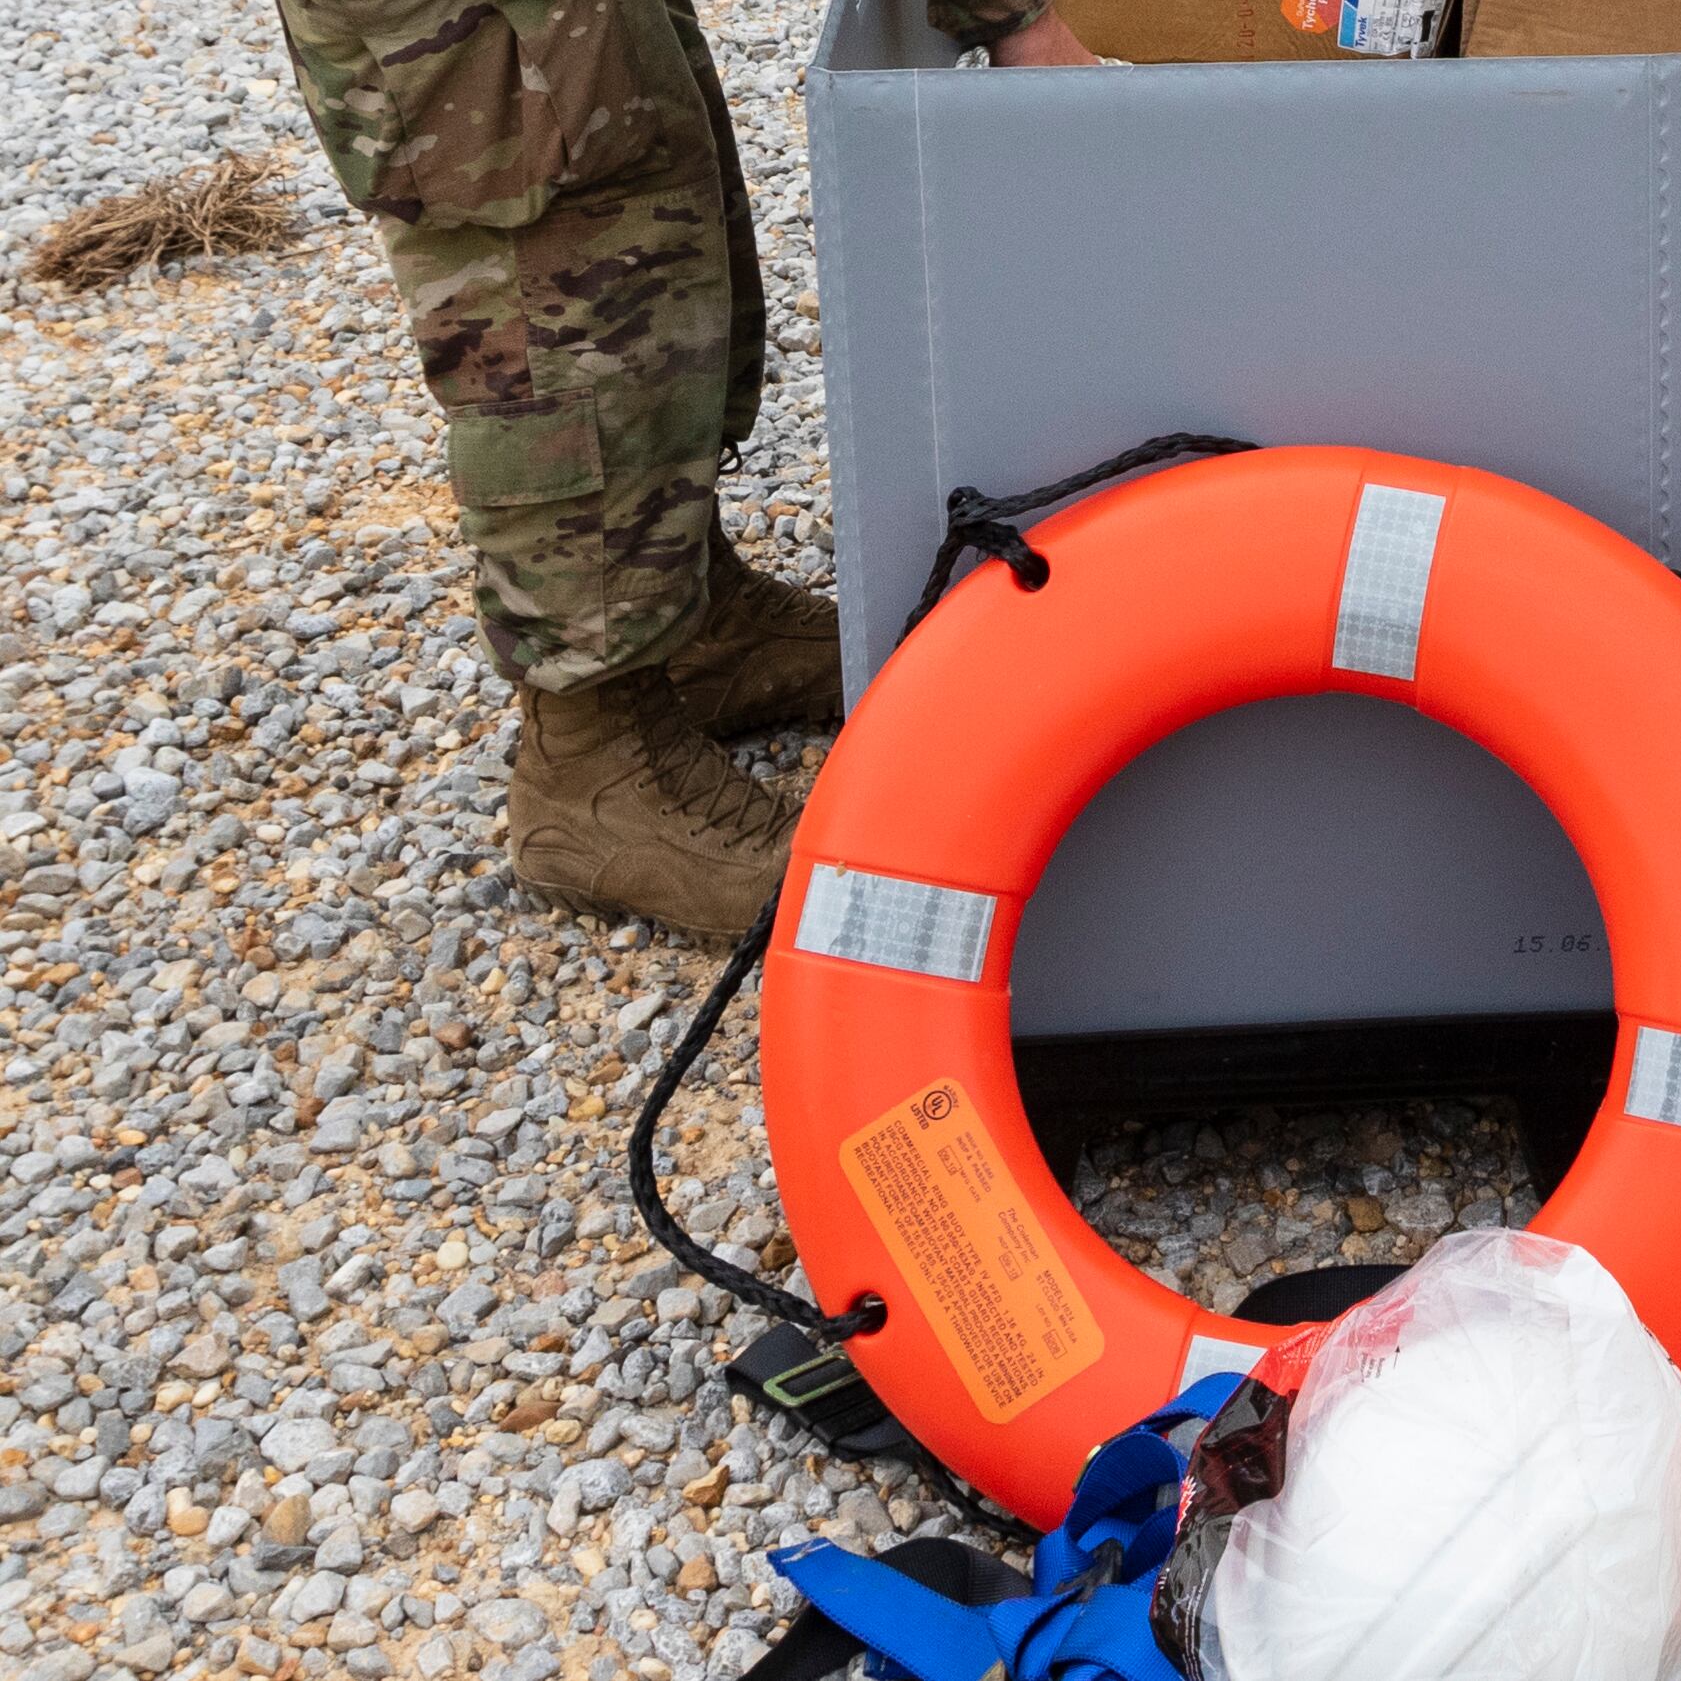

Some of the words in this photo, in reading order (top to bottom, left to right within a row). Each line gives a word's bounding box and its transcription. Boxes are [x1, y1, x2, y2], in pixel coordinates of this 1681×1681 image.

[1354, 15, 1370, 48] Tyvek
[909, 1102, 930, 1131] LISTED
[893, 1118, 933, 1182] COMMERCIAL
[930, 1184, 949, 1209] RING
[945, 1210, 966, 1239] BUOY
[963, 1241, 981, 1266] TYPE
[979, 1269, 990, 1281] IV
[969, 1161, 992, 1194] PASSED
[876, 1129, 887, 1141] IN
[883, 1142, 925, 1207] ACCORDANCE
[921, 1207, 939, 1232] WITH
[947, 1254, 971, 1287] COAST
[967, 1288, 991, 1323] GUARD
[996, 1210, 1023, 1251] Company
[1006, 1206, 1020, 1223] The
[1015, 1222, 1041, 1260] Coleman
[852, 1145, 896, 1216] RECREATIONAL
[892, 1216, 921, 1260] VESSELS
[917, 1260, 936, 1286] ONLY
[933, 1288, 946, 1303] AS
[948, 1314, 985, 1372] THROWABLE
[982, 1373, 1006, 1409] DEVICE
[860, 1140, 889, 1183] BUOYANT
[884, 1183, 906, 1214] FORCE
[902, 1214, 914, 1228] OF
[935, 1271, 955, 1299] USCG
[950, 1299, 983, 1348] APPROVED
[978, 1348, 994, 1368] FOR
[990, 1368, 1005, 1388] USE
[1001, 1388, 1014, 1404] ON
[868, 1135, 910, 1201] POLYURETHANE
[905, 1201, 925, 1227] FOAM
[920, 1226, 948, 1267] BUOYANT
[943, 1266, 972, 1309] MATERIAL
[967, 1308, 997, 1353] PROVIDES
[996, 1359, 1022, 1398] MINIMUM
[885, 1124, 904, 1151] USCG
[899, 1150, 930, 1196] APPROVAL
[974, 1280, 1007, 1331] INSPECTED
[1002, 1330, 1018, 1352] AND
[1014, 1351, 1039, 1387] TESTED
[1041, 1269, 1065, 1302] MODEL
[1064, 1326, 1078, 1344] USA
